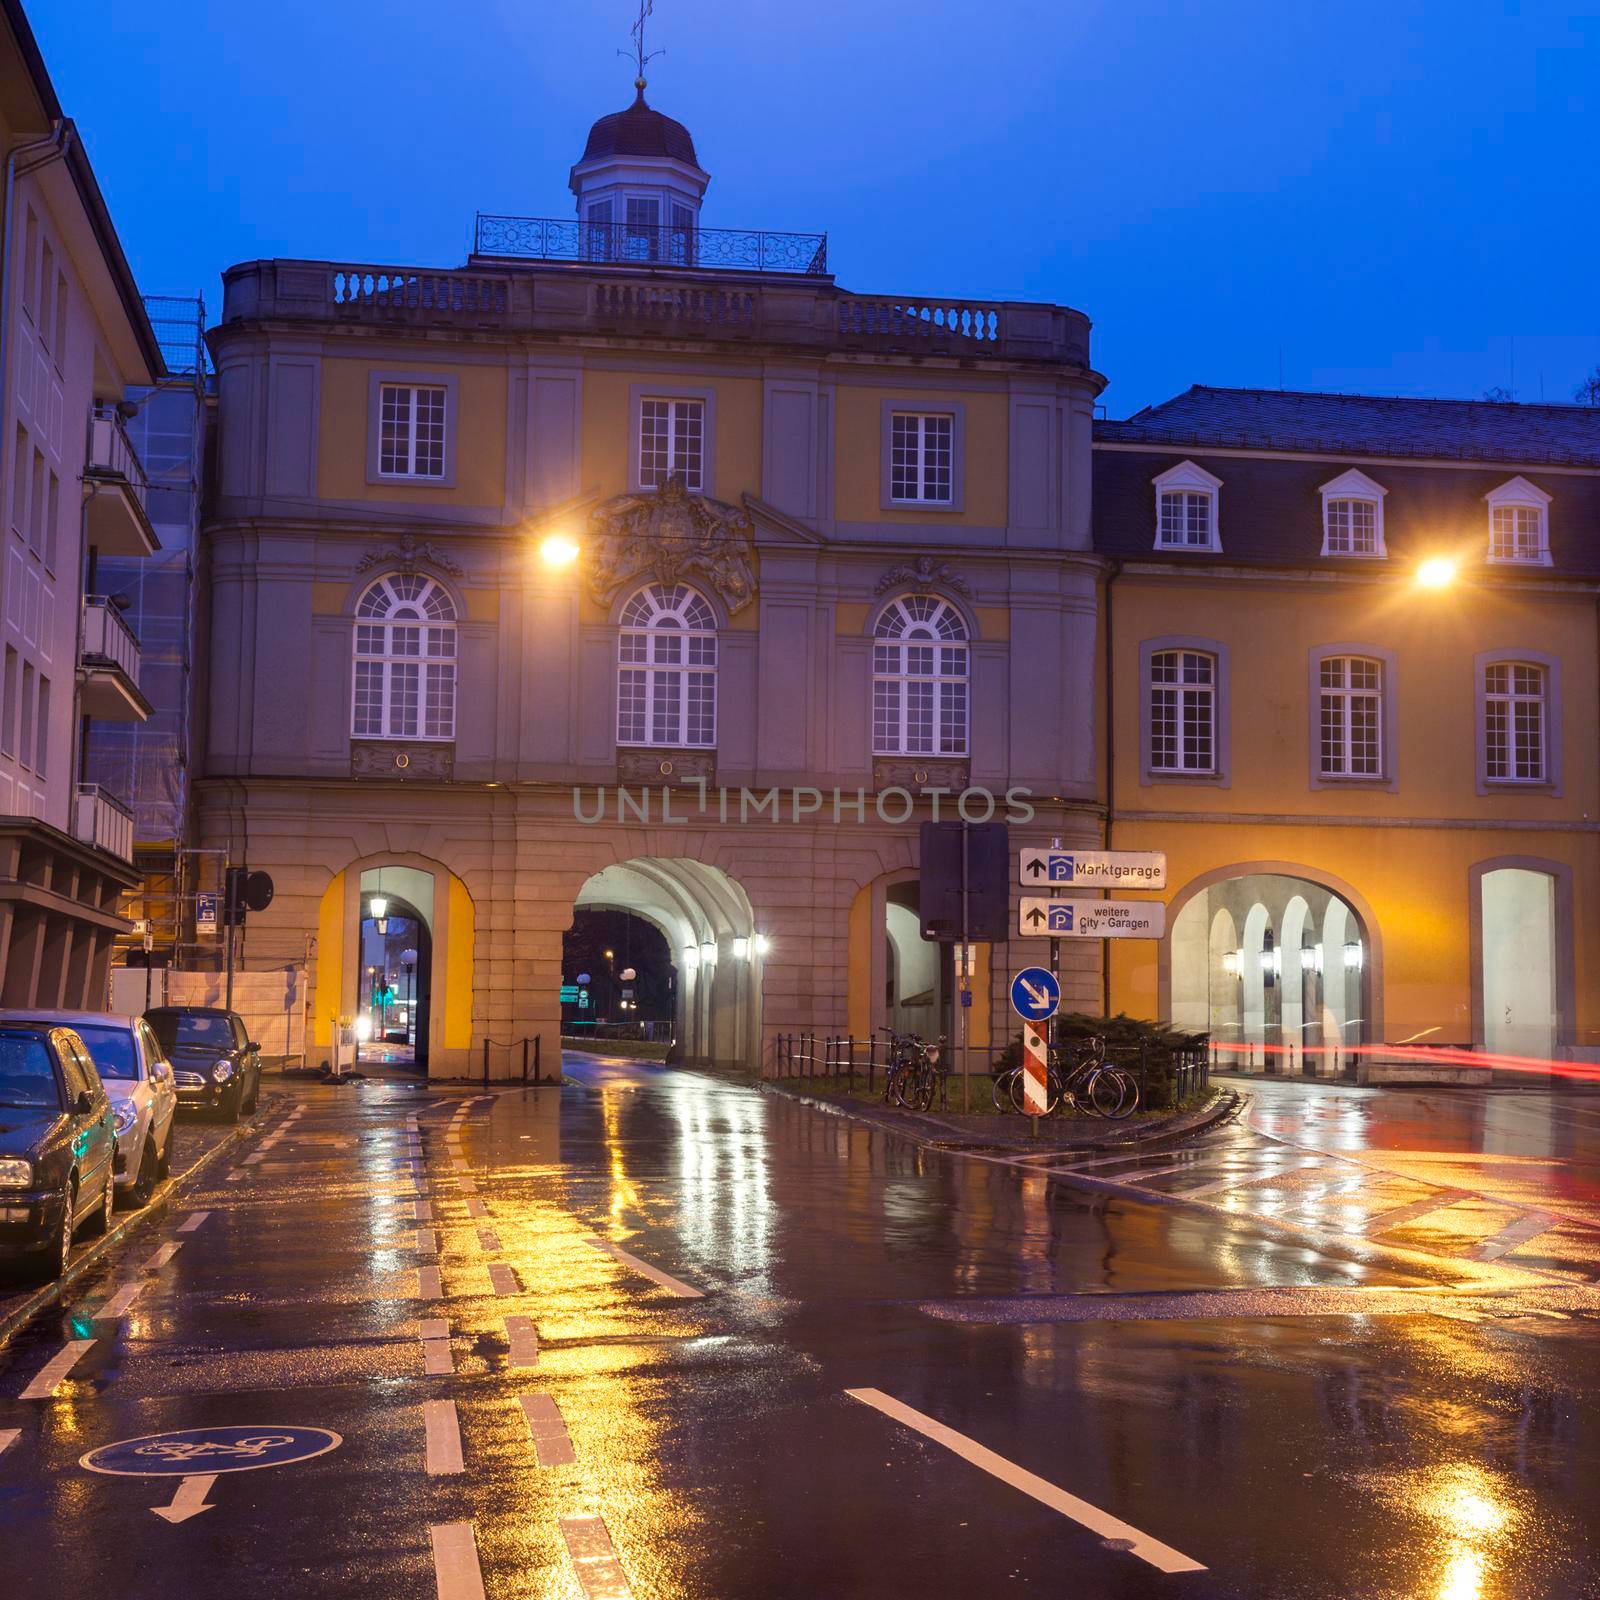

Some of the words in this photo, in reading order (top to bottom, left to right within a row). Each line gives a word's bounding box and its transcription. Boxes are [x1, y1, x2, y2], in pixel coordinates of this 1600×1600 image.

[1055, 865, 1067, 880] P
[1075, 863, 1161, 879] Marktgarage
[1094, 907, 1130, 917] weitere
[1055, 914, 1067, 929] P
[1079, 917, 1099, 930] City
[1107, 917, 1150, 930] Garagen
